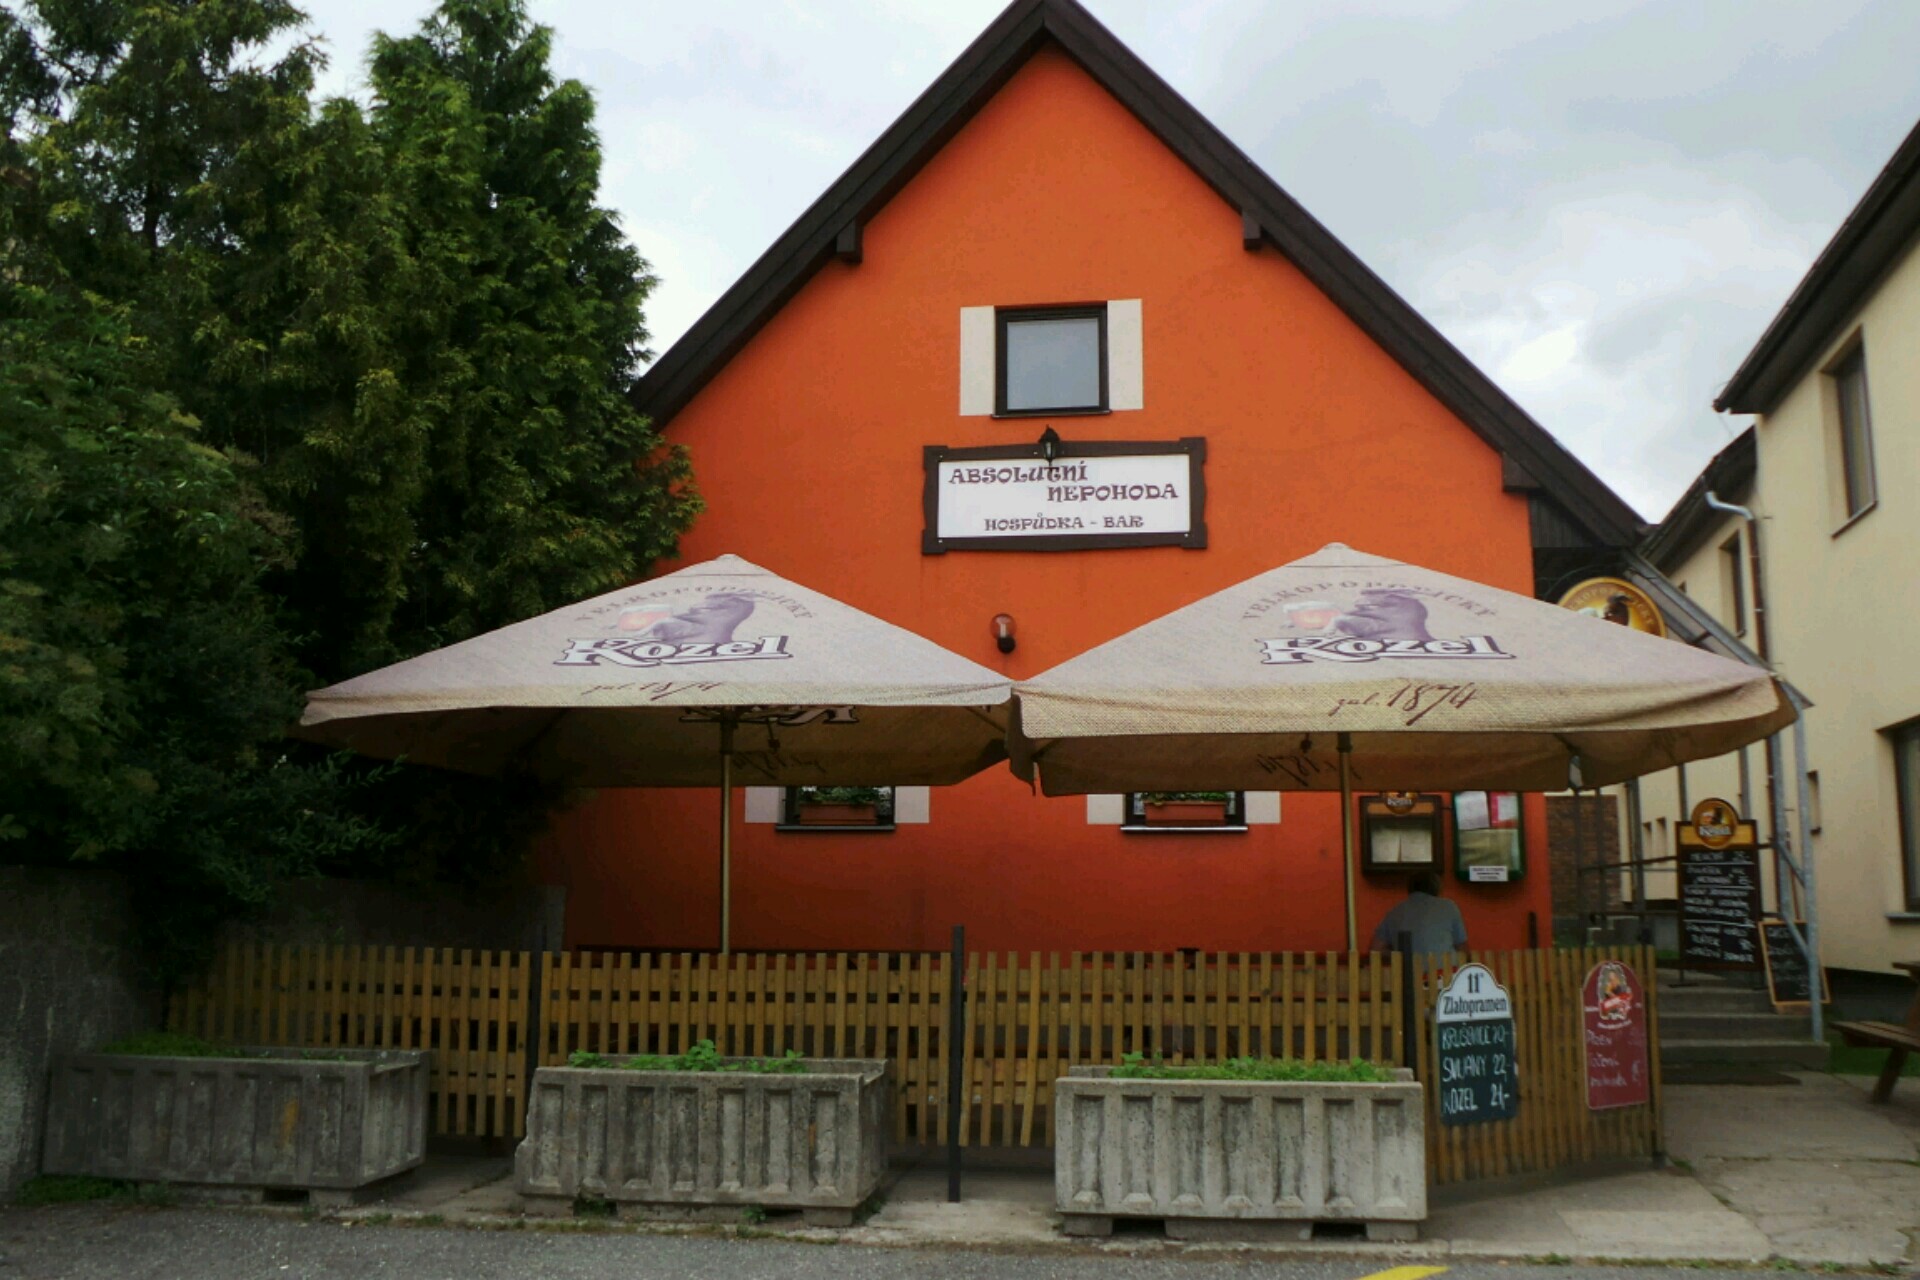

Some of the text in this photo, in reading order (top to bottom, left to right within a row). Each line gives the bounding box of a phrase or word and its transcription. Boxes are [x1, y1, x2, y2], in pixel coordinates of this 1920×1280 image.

[948, 460, 1088, 484] ABSOLUTNÍ
[1047, 484, 1179, 502] NEPOHODA
[983, 512, 1084, 532] HOSPŮDKA
[1103, 515, 1144, 529] BAR
[553, 635, 794, 668] Kozel
[1254, 635, 1516, 664] Kozel
[1387, 677, 1478, 726] 1874
[1443, 996, 1507, 1017] Zlatopramen
[1443, 1087, 1479, 1115] KOZEL
